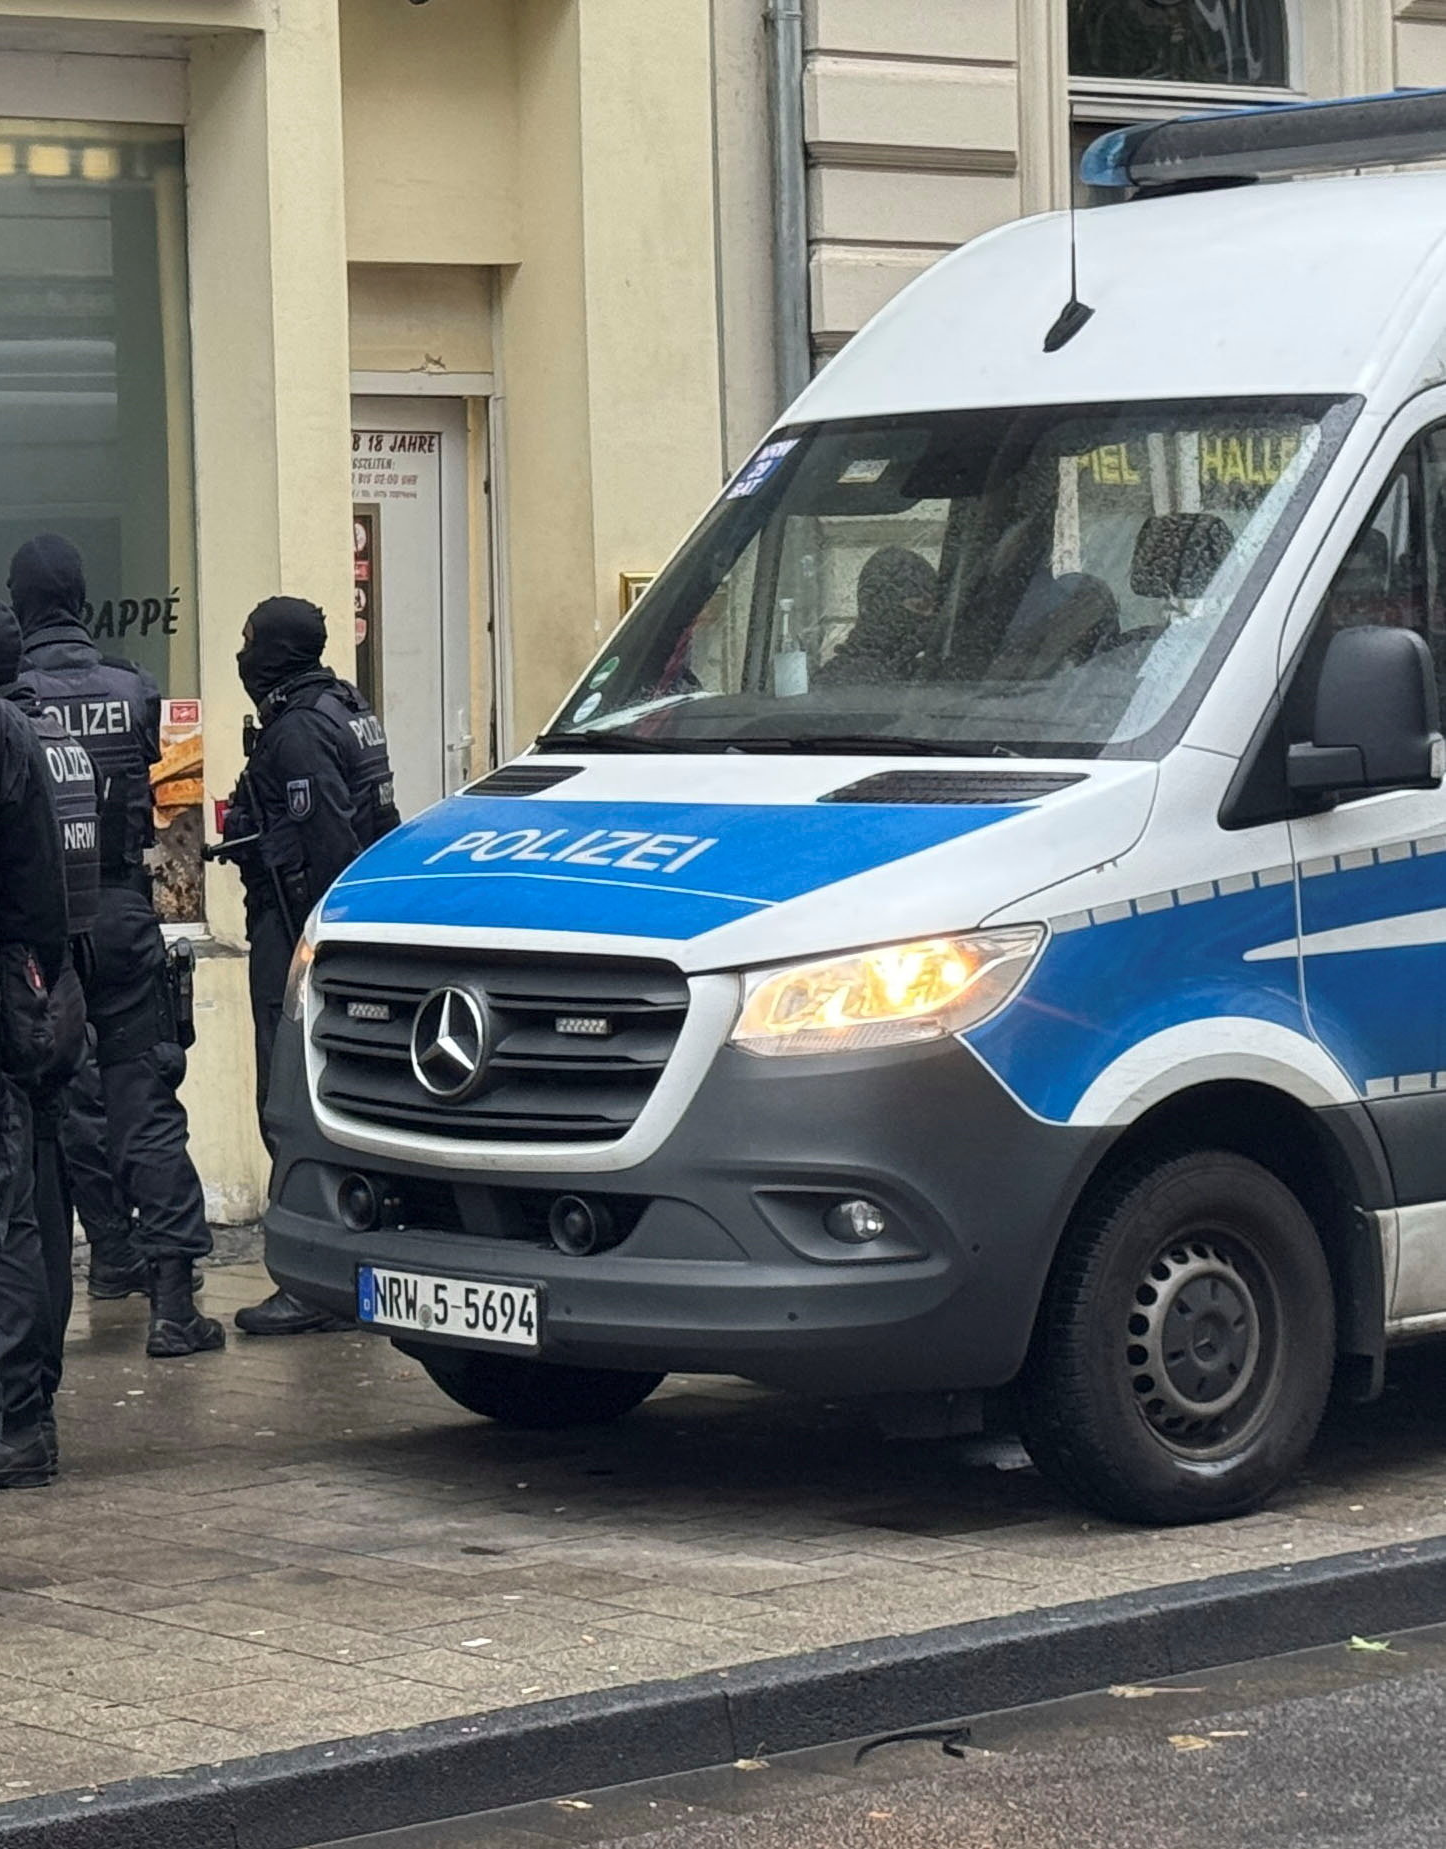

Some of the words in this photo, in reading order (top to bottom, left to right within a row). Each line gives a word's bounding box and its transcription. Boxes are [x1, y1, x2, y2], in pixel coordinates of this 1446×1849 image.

[351, 433, 362, 452] B
[368, 434, 384, 452] 18
[389, 434, 436, 454] JAHRE
[1077, 443, 1141, 486] PIEL
[81, 586, 180, 639] APPÉ
[42, 700, 131, 736] OLIZEI
[46, 746, 95, 784] OLIZEI
[64, 822, 96, 850] NRW
[422, 828, 720, 873] POLIZEI
[374, 1274, 418, 1321] NRW
[434, 1283, 535, 1336] 5-5694
